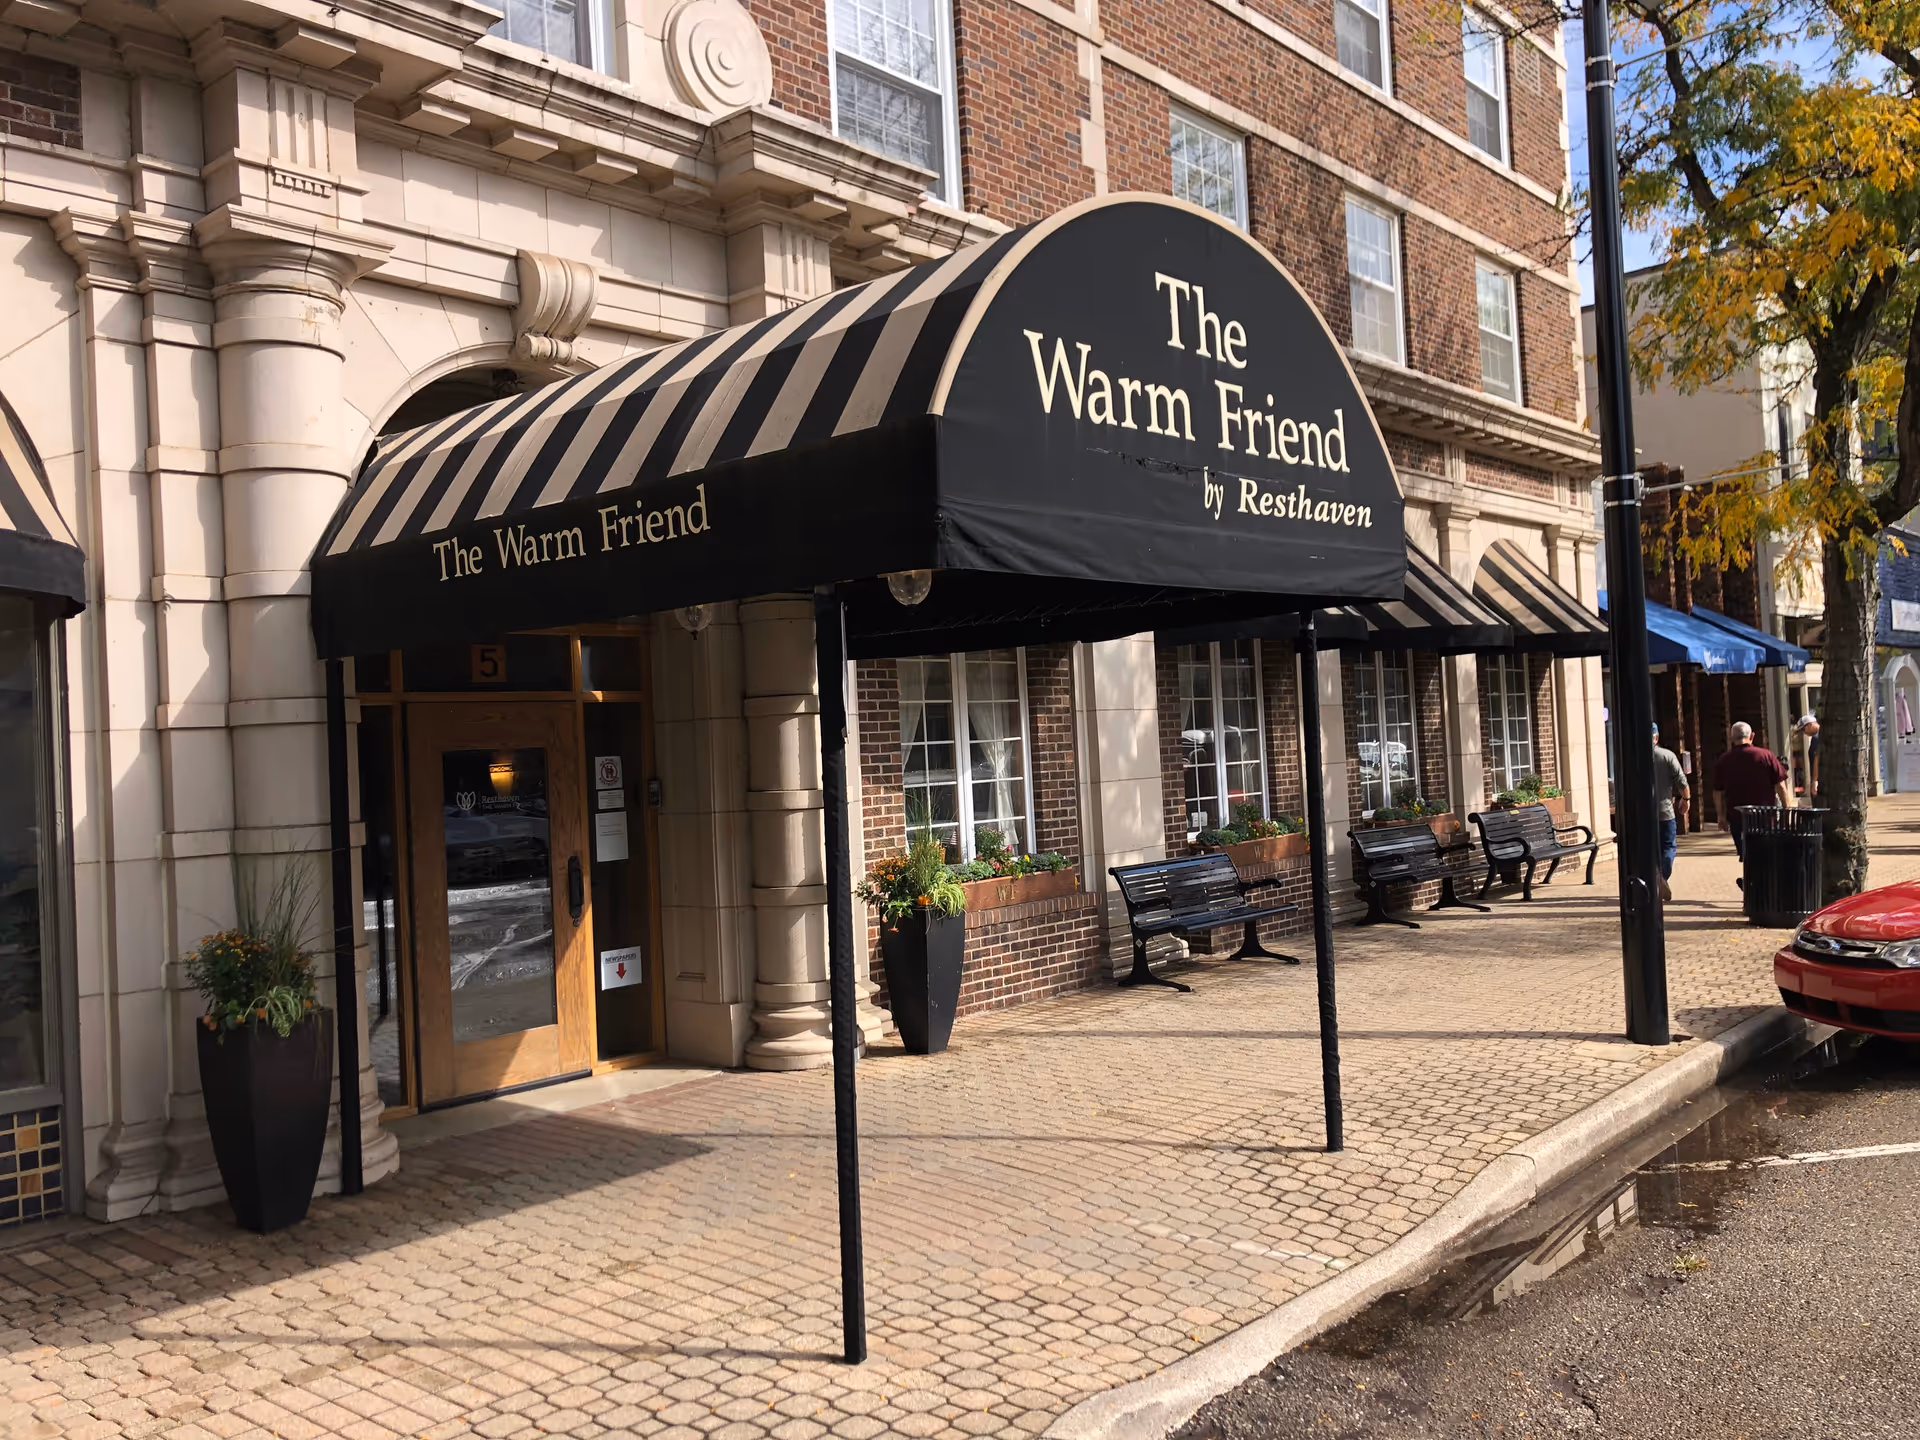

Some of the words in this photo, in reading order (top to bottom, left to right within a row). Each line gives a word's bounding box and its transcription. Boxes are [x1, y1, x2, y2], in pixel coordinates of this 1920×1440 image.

[1154, 271, 1248, 369] The
[1023, 328, 1196, 442] Warm
[1214, 380, 1351, 474] Friend
[432, 536, 484, 582] The
[493, 524, 587, 569] Warm
[597, 483, 711, 552] Friend
[1203, 466, 1224, 521] by
[1238, 477, 1374, 529] Resthaven
[481, 648, 499, 678] 5
[605, 952, 637, 963] NEWSPAPERS
